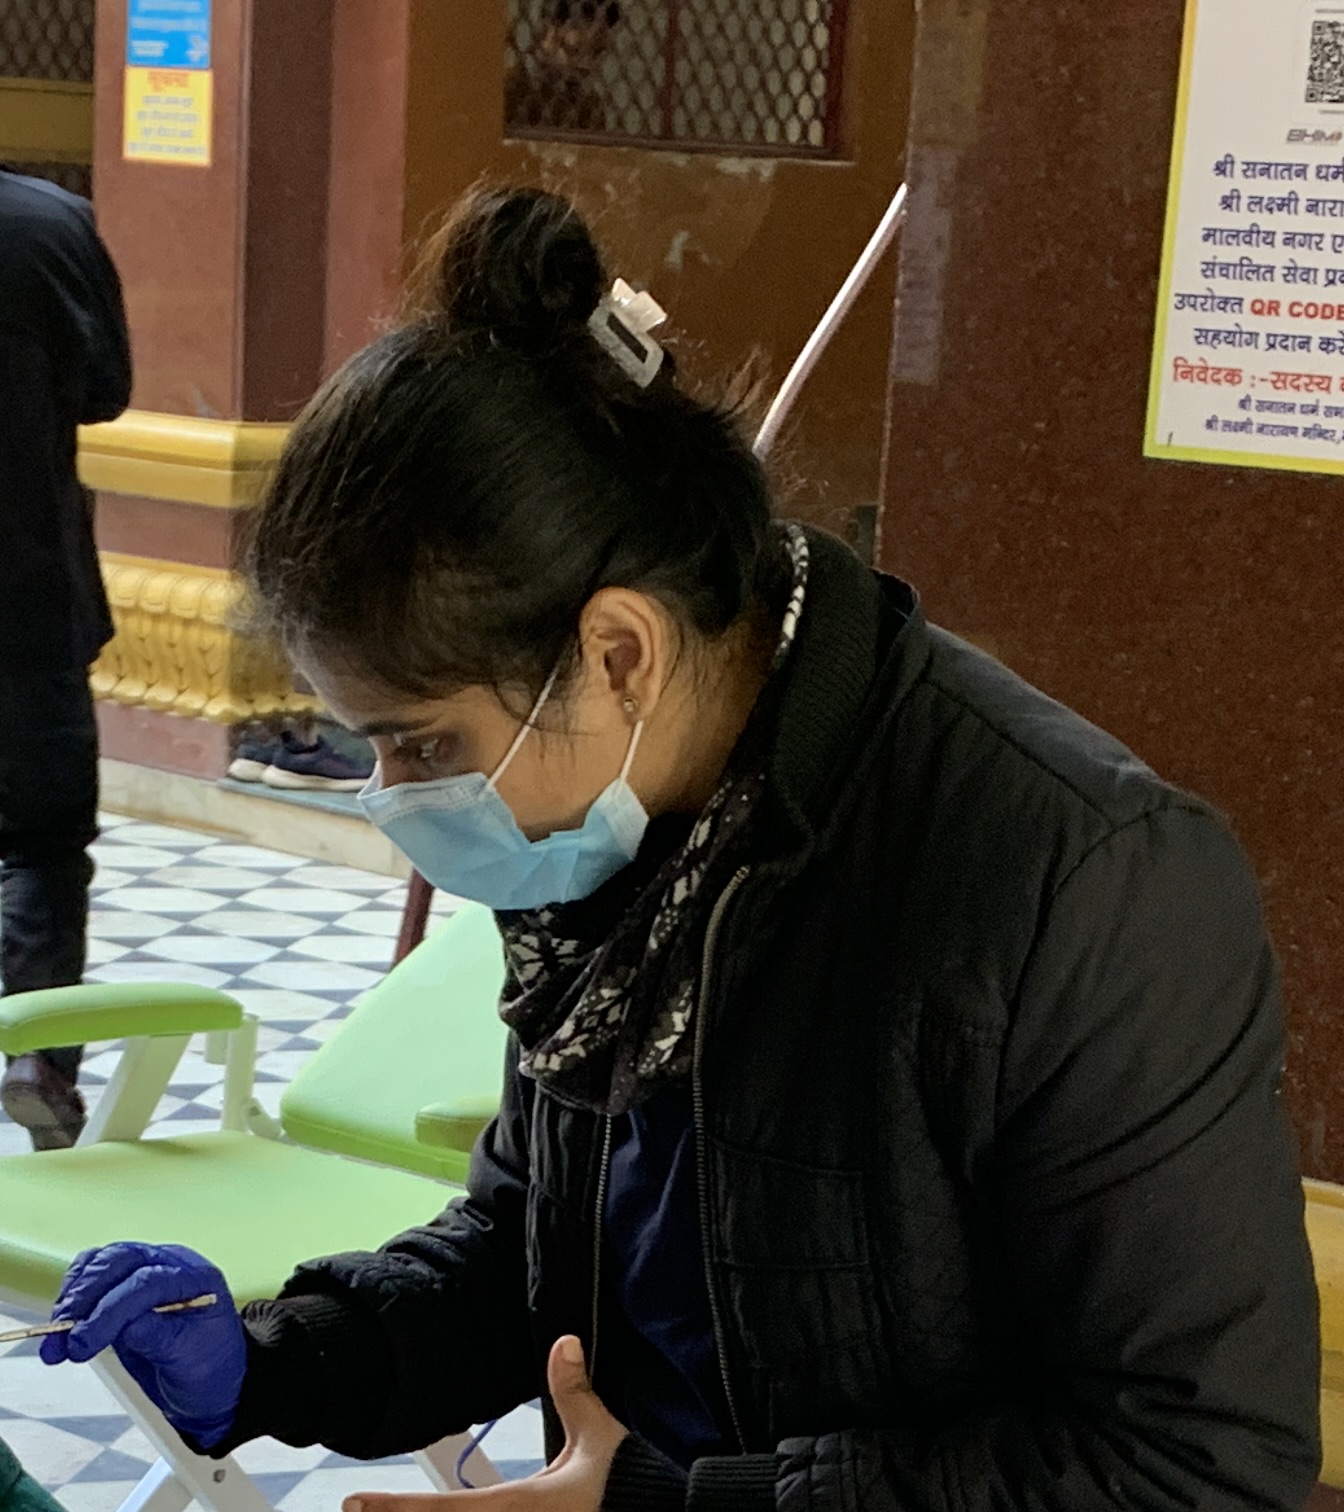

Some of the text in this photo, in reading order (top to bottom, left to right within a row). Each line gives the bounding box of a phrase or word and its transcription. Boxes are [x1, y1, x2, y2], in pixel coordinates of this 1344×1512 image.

[1213, 154, 1235, 179] श्री
[1242, 161, 1309, 180] सनातन
[1219, 189, 1241, 213] श्री
[1247, 191, 1299, 216] लक्ष्मी
[1201, 223, 1276, 248] मालवीय
[1283, 231, 1324, 251] नगर
[1201, 256, 1276, 282] संचालित
[1282, 258, 1318, 285] सेवा
[1174, 288, 1244, 314] उपरोक्त
[1250, 299, 1280, 316] QR
[1194, 323, 1259, 349] सहयोग
[1265, 333, 1312, 351] प्रदान
[1173, 357, 1242, 385] निवेदक
